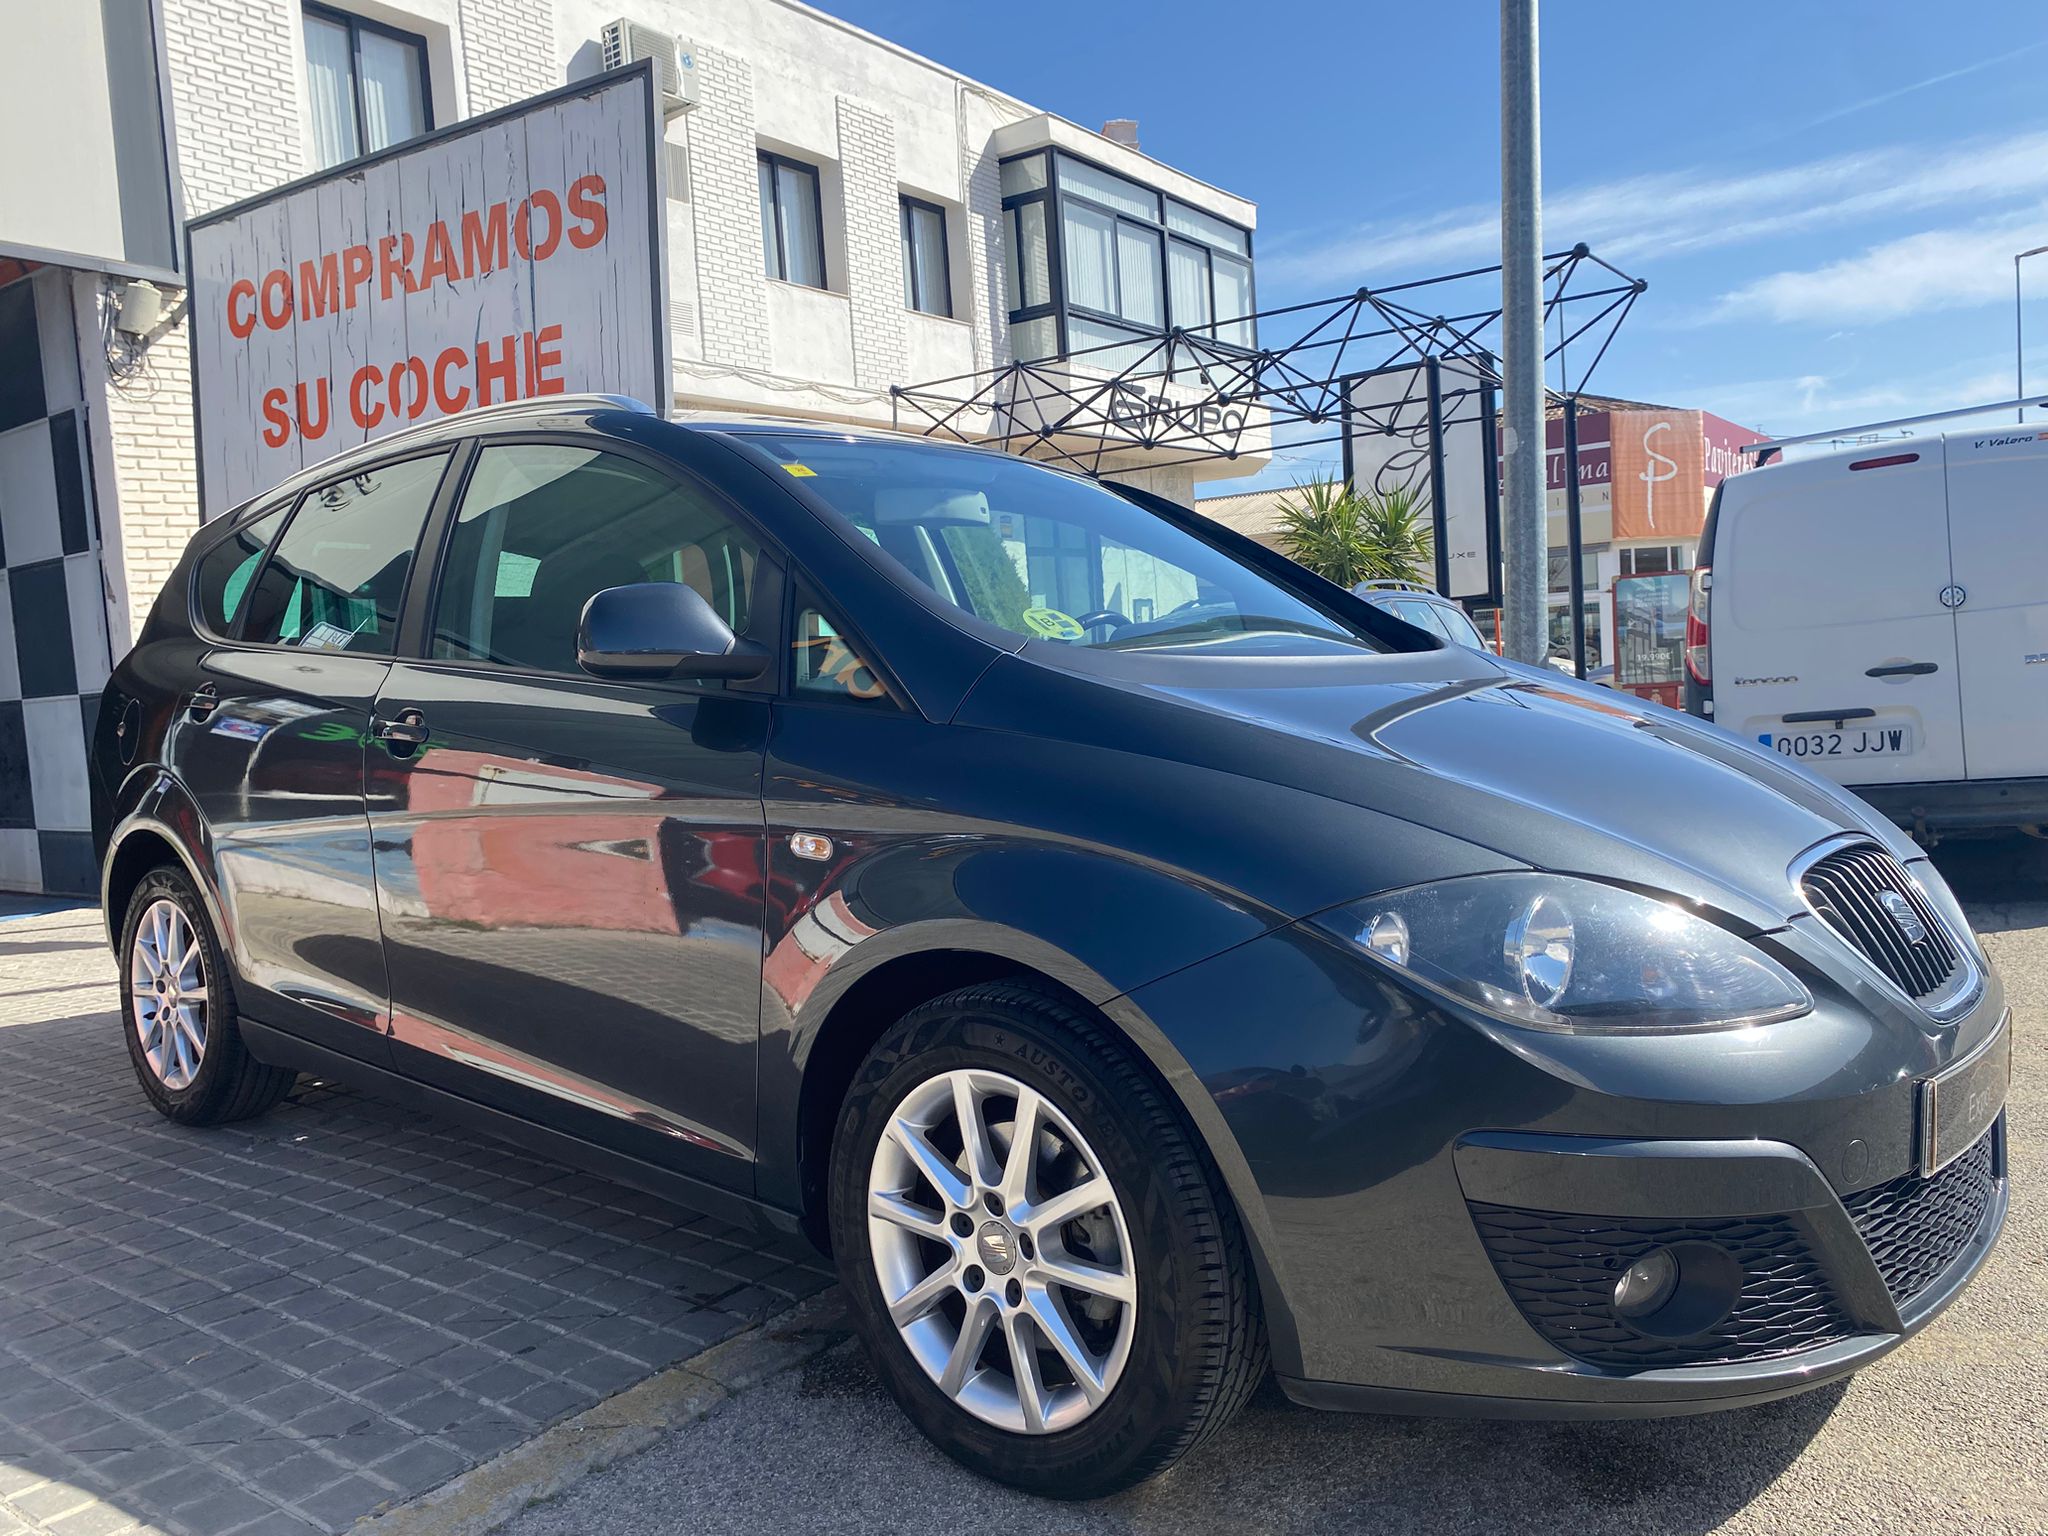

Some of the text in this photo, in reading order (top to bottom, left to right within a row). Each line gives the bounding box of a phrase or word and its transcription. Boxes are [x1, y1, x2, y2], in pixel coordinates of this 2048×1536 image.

[227, 174, 609, 338] COMPRAMOS
[262, 324, 566, 448] SU COCHE
[1111, 383, 1243, 438] GRUPO
[1777, 730, 1902, 756] 0032 JJW
